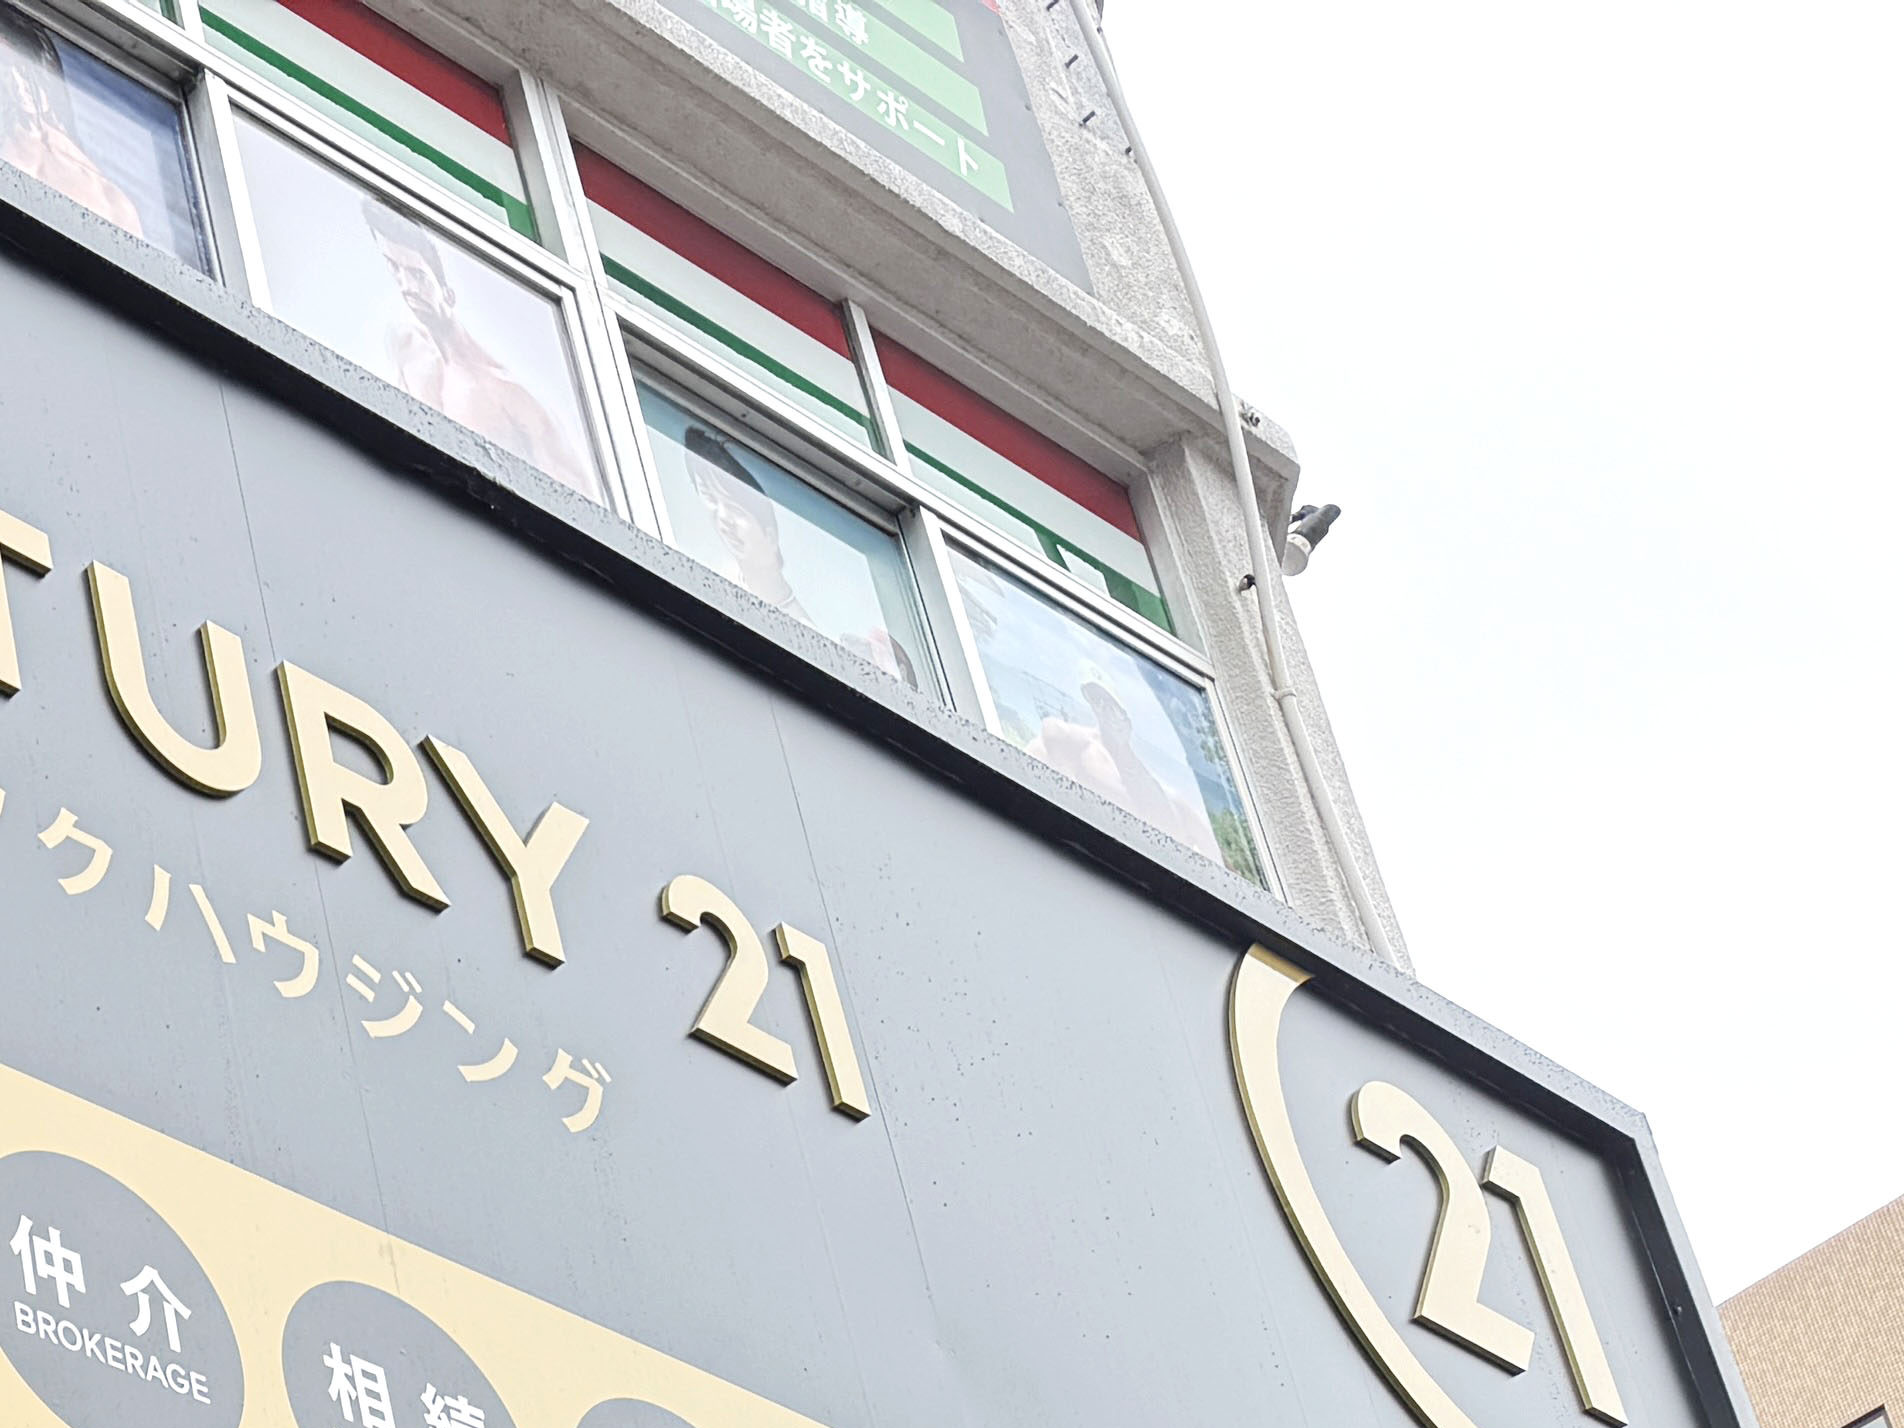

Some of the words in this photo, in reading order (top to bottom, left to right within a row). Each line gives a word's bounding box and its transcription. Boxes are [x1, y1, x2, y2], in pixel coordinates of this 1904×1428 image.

[702, 0, 980, 177] 場者をサポート
[797, 0, 870, 44] 導
[658, 873, 871, 1123] 21
[13, 1300, 212, 1405] BROKERAGE
